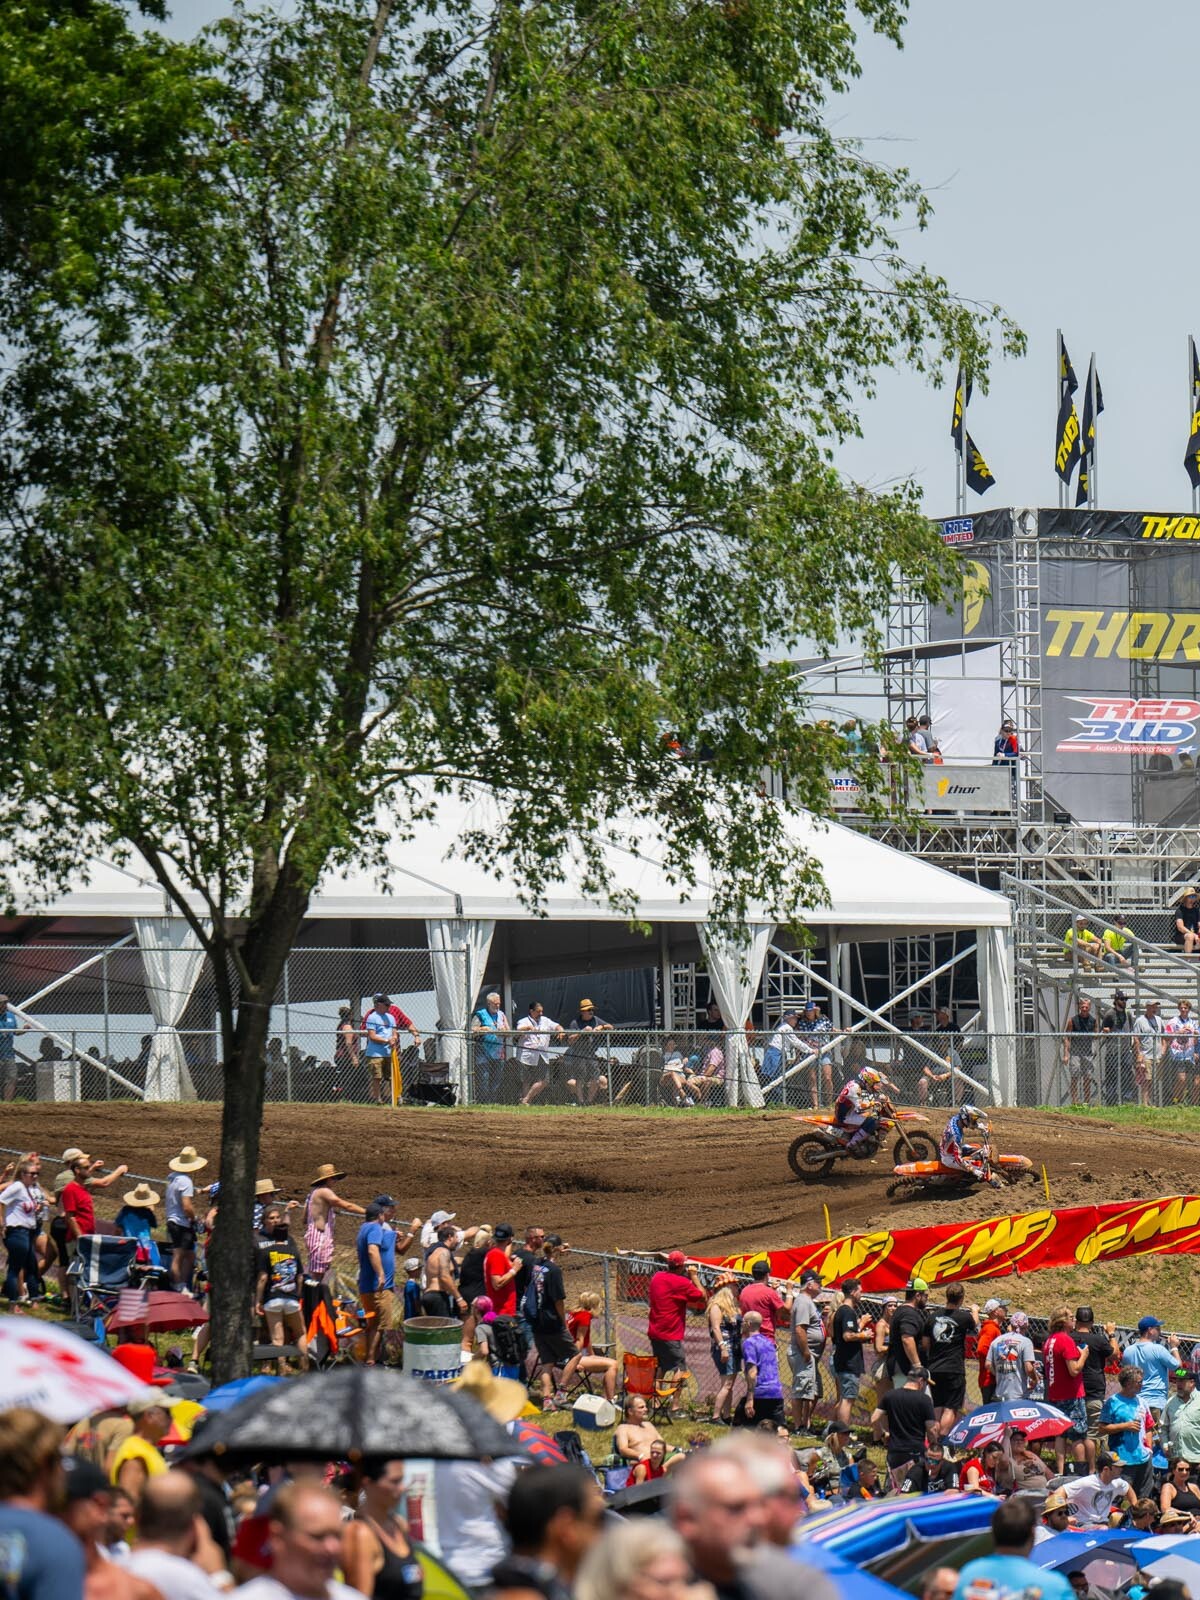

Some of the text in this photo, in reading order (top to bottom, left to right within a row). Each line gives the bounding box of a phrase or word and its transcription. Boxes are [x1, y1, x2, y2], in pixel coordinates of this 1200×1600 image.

[1063, 718, 1196, 743] BUD
[948, 785, 981, 794] thor
[806, 1231, 890, 1287] MF
[919, 1209, 1052, 1284] FMF
